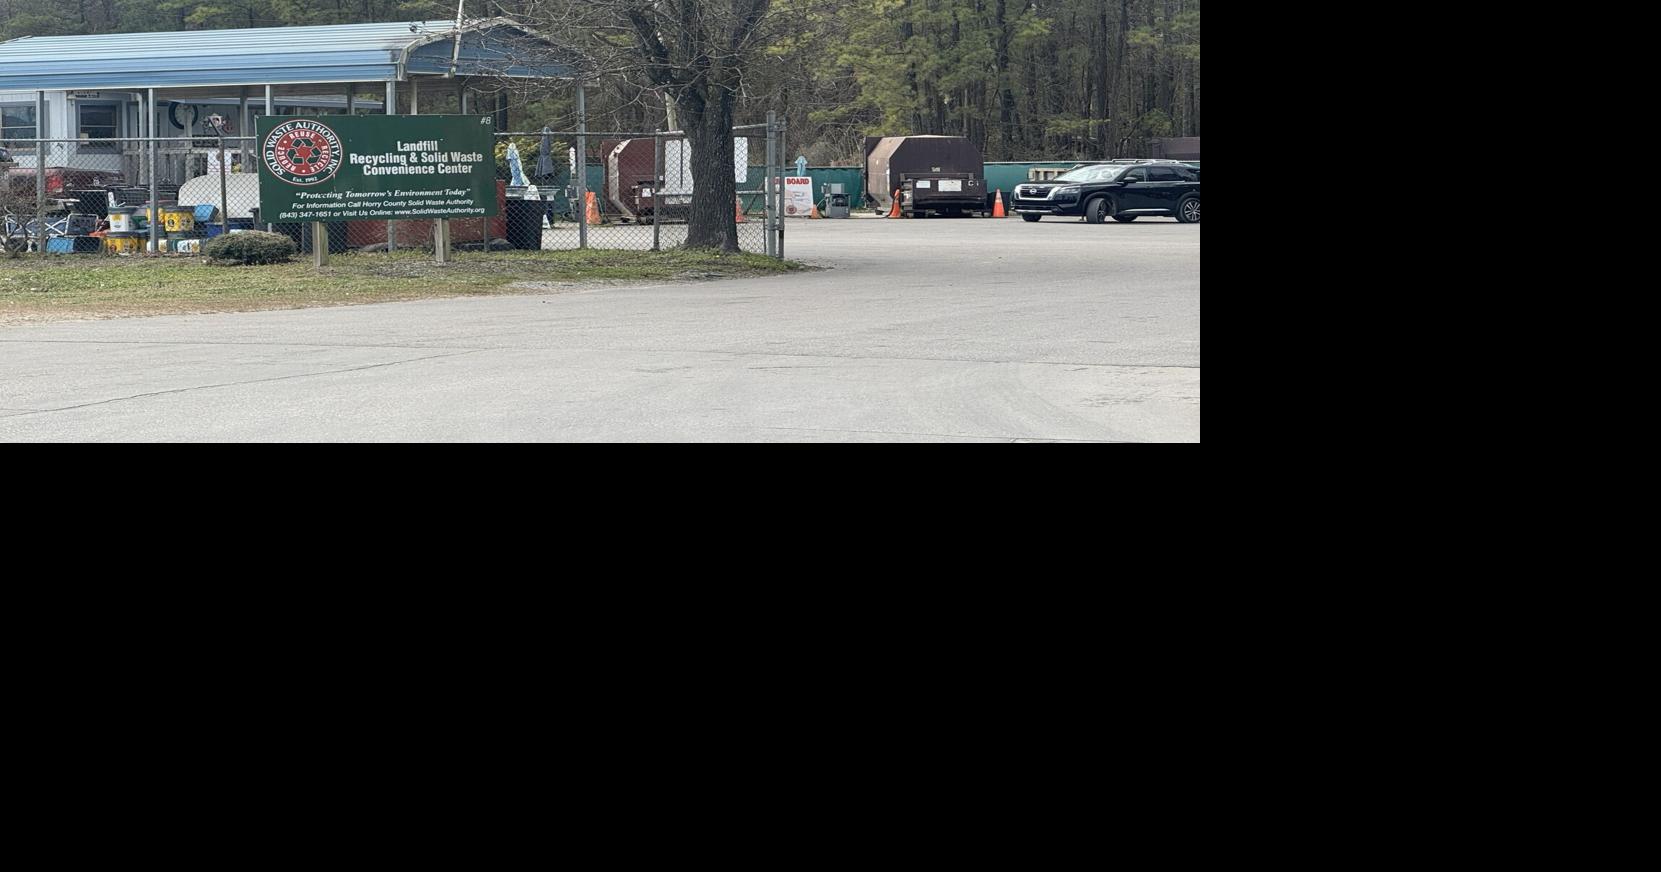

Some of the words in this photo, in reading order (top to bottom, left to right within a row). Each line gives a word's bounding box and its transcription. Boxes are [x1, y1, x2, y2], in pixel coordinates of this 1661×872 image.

[480, 116, 492, 124] #8
[266, 124, 294, 148] WASTE
[288, 131, 316, 139] REUSE
[396, 140, 438, 152] Landfill
[266, 150, 286, 176] SOLID
[277, 146, 297, 172] REDUCE
[310, 146, 329, 172] RECYCLE
[350, 152, 407, 165] Recycling
[409, 152, 418, 163] &
[420, 152, 448, 163] Solid
[450, 151, 483, 162] Waste
[363, 164, 435, 176] Convenience
[438, 163, 472, 174] Center
